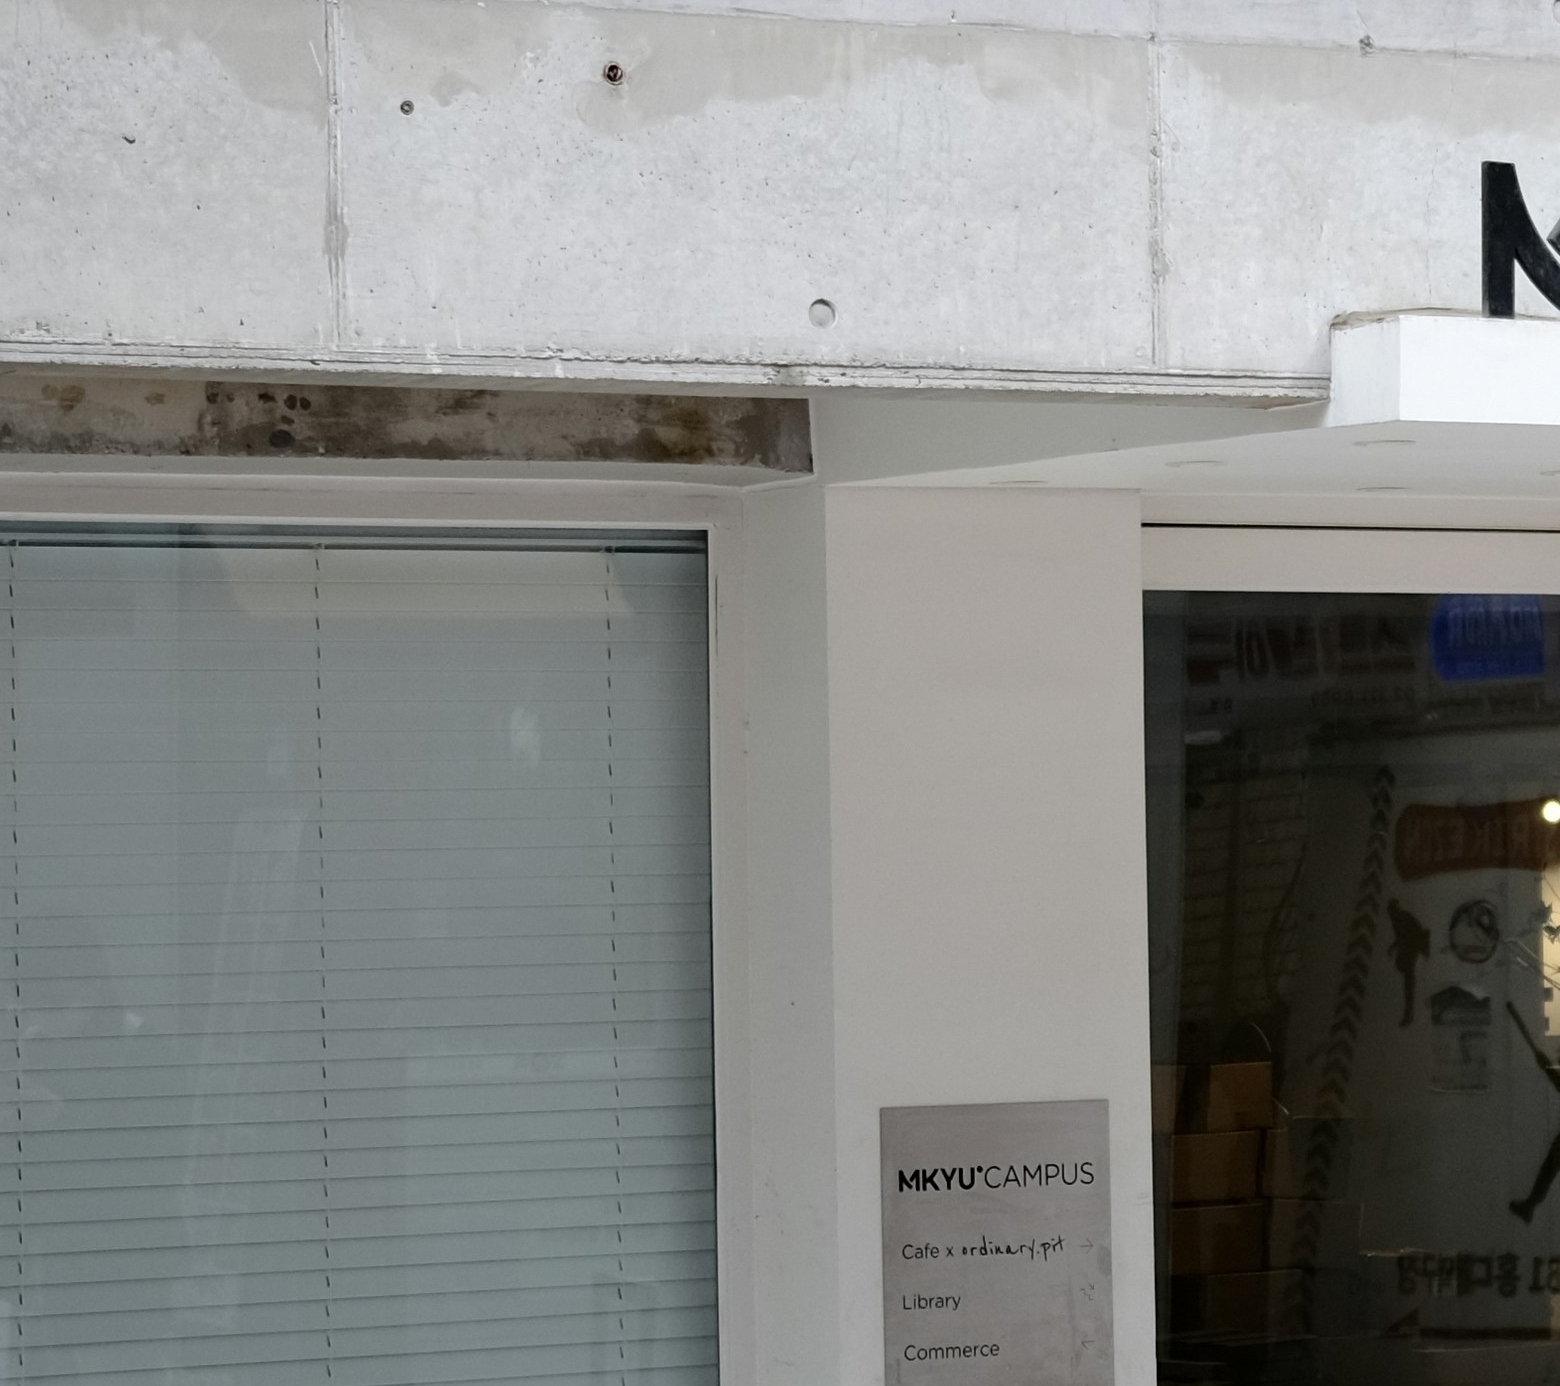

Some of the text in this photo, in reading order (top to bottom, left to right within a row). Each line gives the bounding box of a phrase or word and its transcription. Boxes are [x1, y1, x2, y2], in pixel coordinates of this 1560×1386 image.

[902, 1243, 940, 1260] Cafe
[902, 1295, 962, 1311] Library
[903, 1342, 1000, 1362] Commerce
